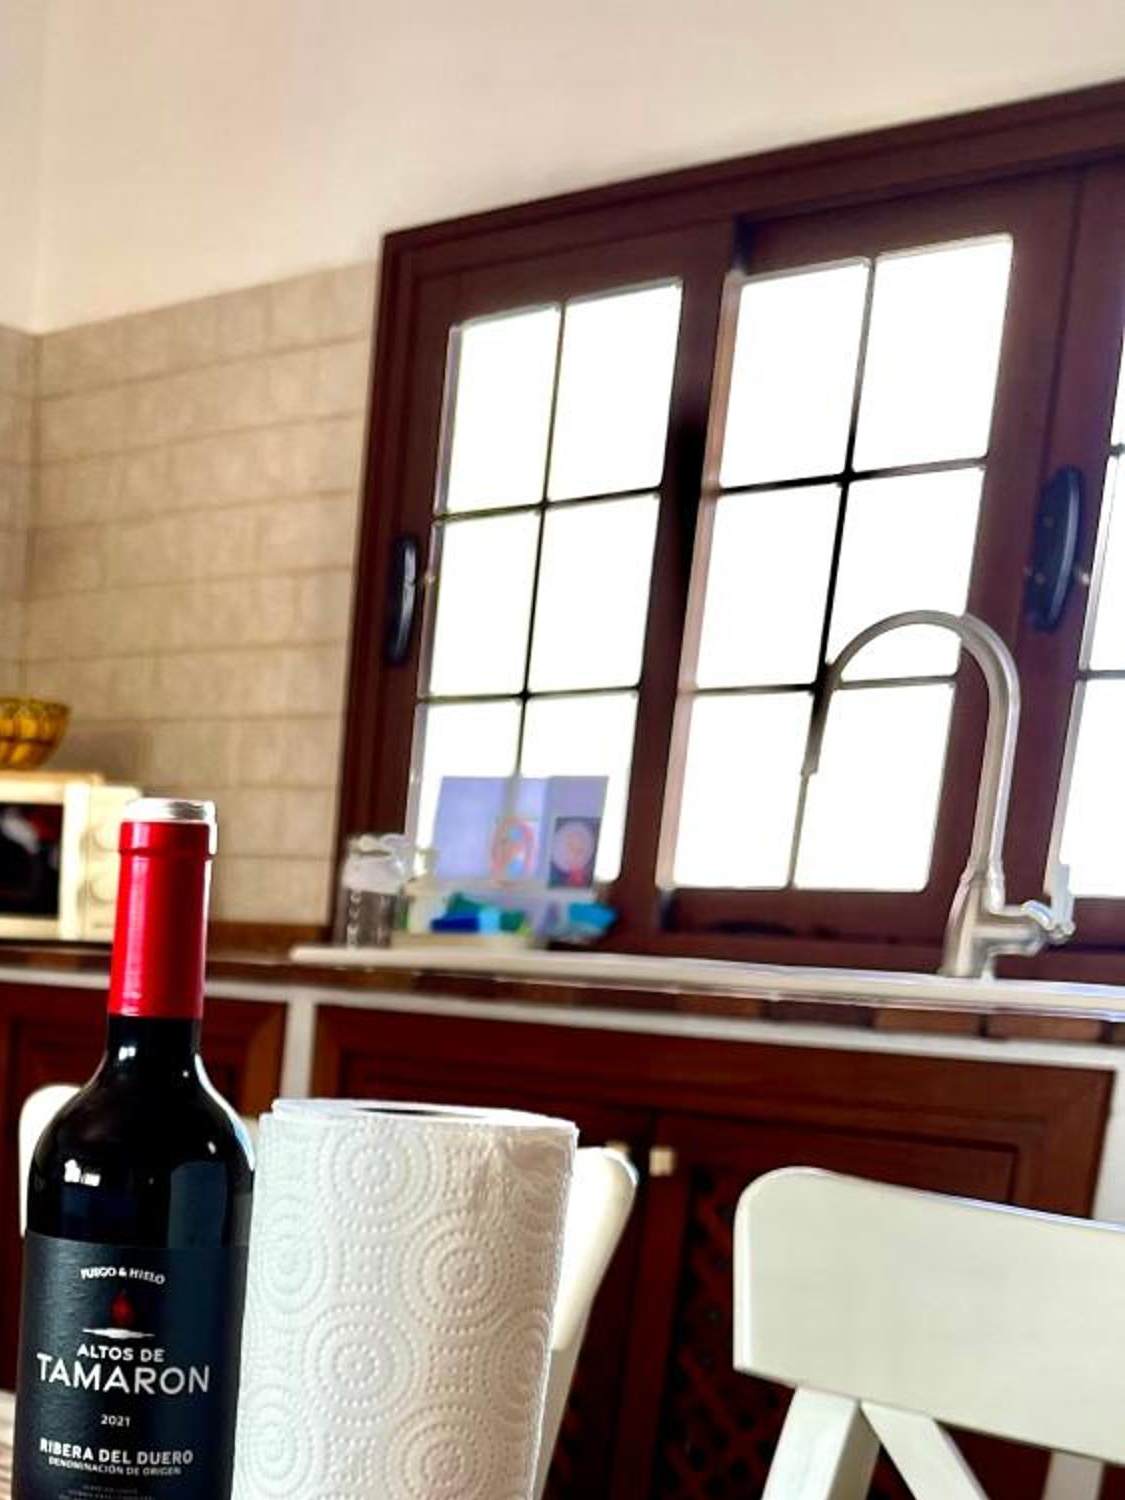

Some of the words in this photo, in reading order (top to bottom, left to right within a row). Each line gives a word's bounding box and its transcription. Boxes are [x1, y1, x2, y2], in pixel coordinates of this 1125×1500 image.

[77, 1344, 134, 1361] ALTOS
[140, 1348, 165, 1363] DE
[36, 1352, 210, 1395] TAMARON
[101, 1414, 131, 1428] 2021
[40, 1437, 94, 1461] RIBERA
[98, 1448, 132, 1464] DEL
[136, 1450, 194, 1466] DUERO
[126, 1466, 140, 1476] DE
[142, 1466, 182, 1477] ORIGEN
